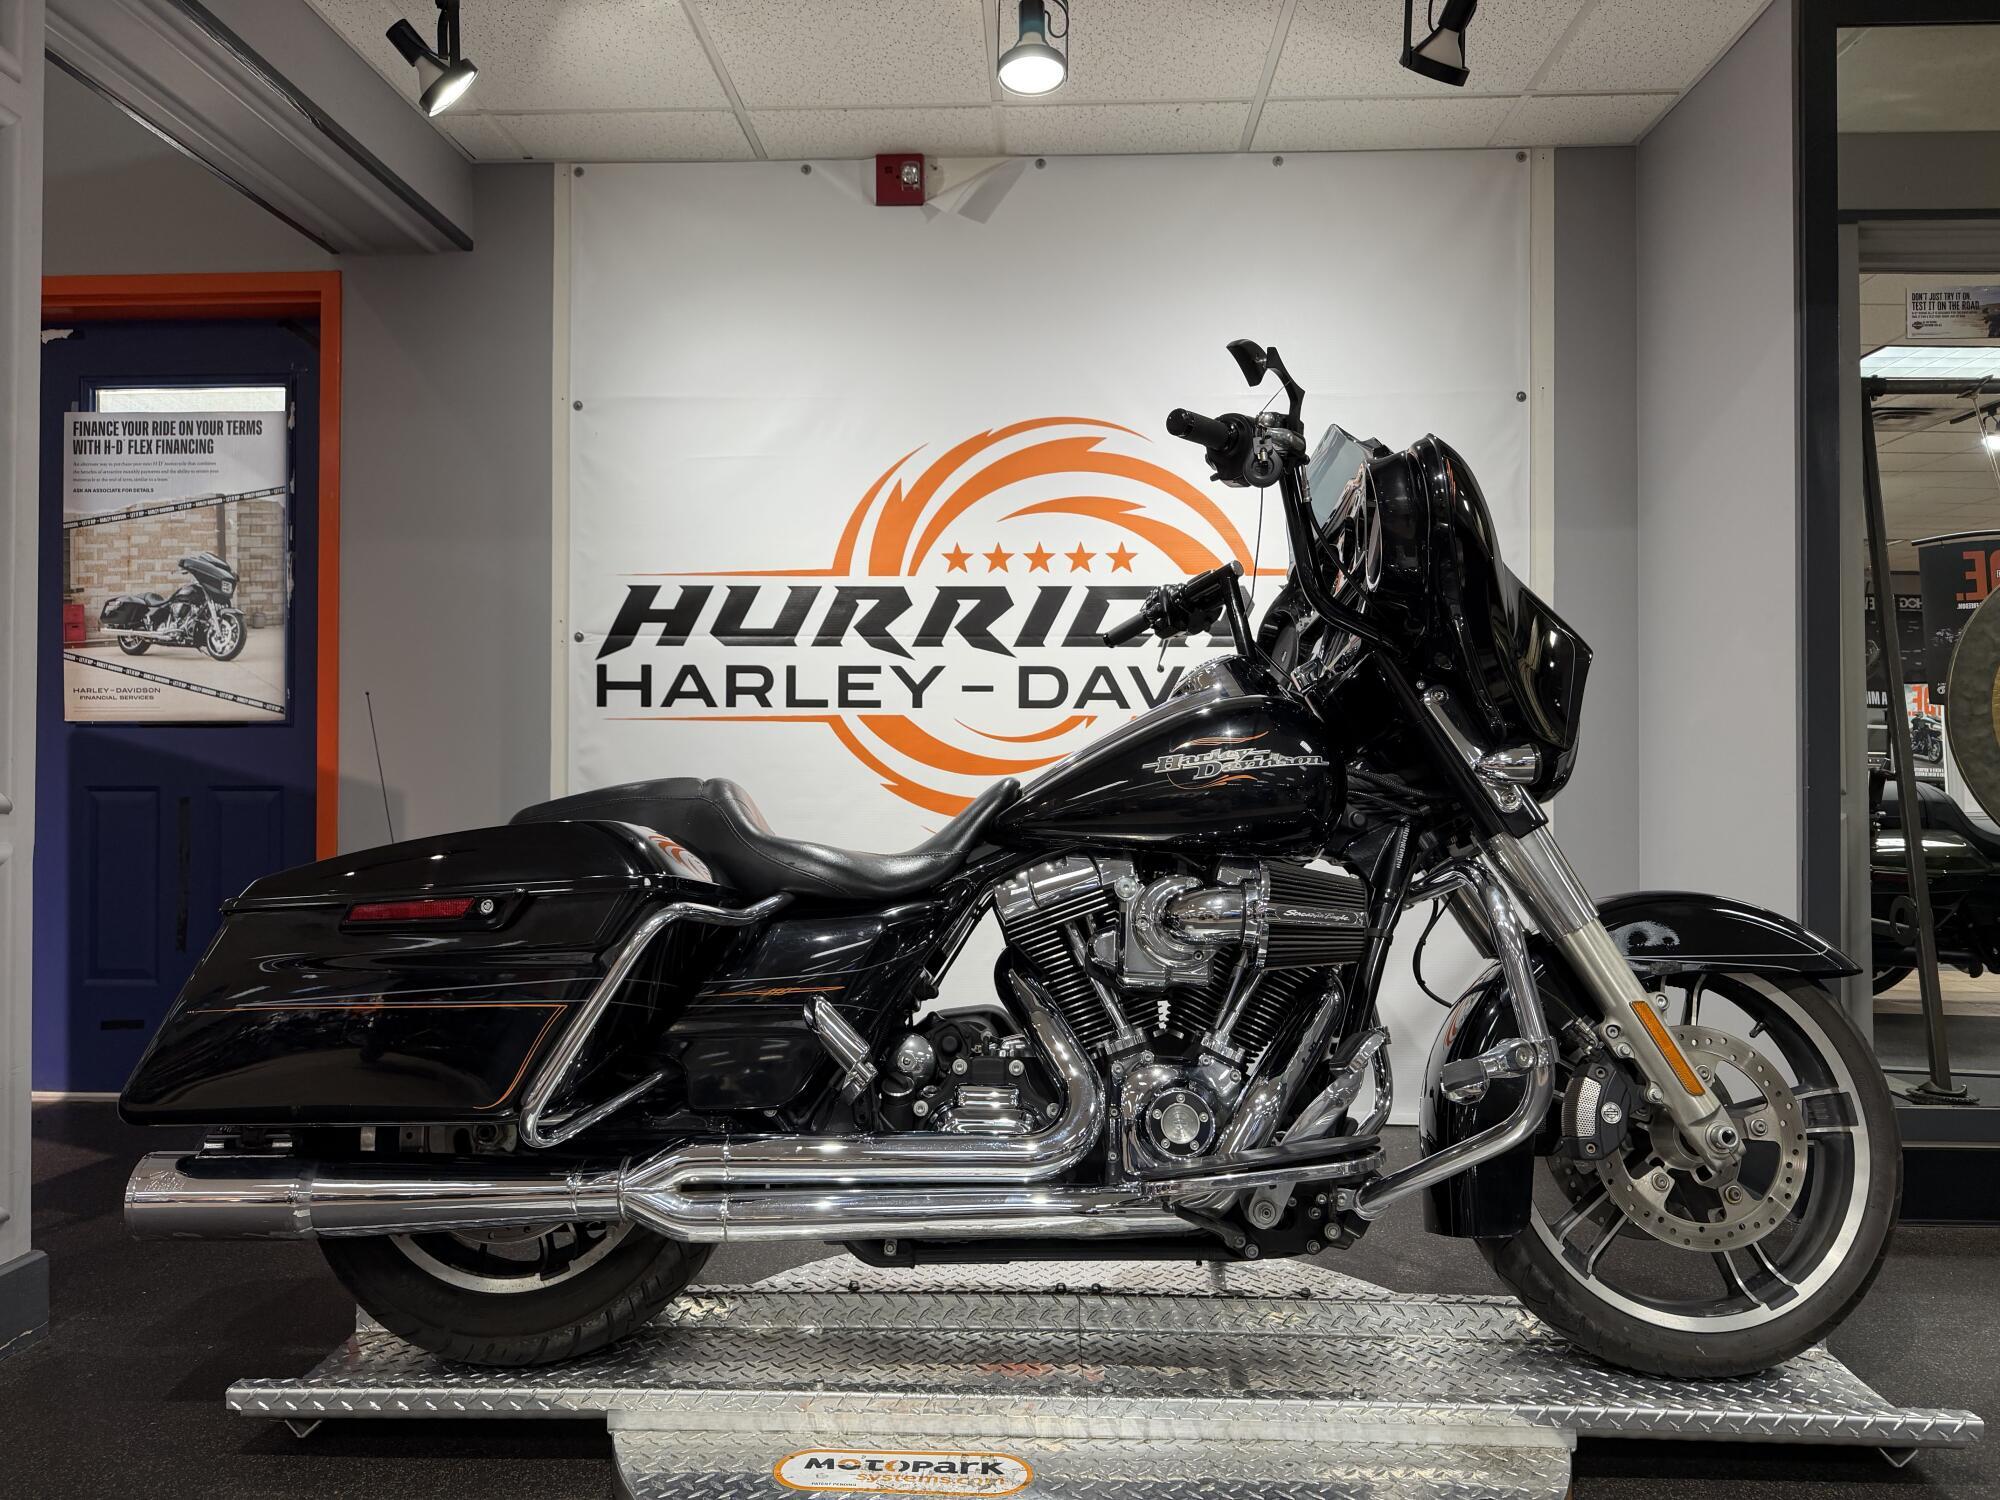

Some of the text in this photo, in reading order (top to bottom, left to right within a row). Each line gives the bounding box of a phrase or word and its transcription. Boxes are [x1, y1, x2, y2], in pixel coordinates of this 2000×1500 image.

[1911, 292, 1927, 300] DON'T
[1929, 292, 1942, 300] JUST
[1944, 292, 1954, 300] TRY
[1955, 292, 1961, 300] IT
[1912, 301, 1926, 310] TEST
[1928, 301, 1935, 310] IT
[1937, 301, 1946, 310] ON
[1948, 301, 1959, 310] THE
[73, 420, 262, 436] FINANCE YOUR RIDE ON YOUR TERMS
[73, 439, 101, 454] WITH
[128, 439, 153, 454] FLEX
[156, 438, 214, 454] FINANCING
[1155, 748, 1258, 774] Harley
[1192, 751, 1323, 780] Davidson
[856, 1472, 1005, 1486] systems.com
